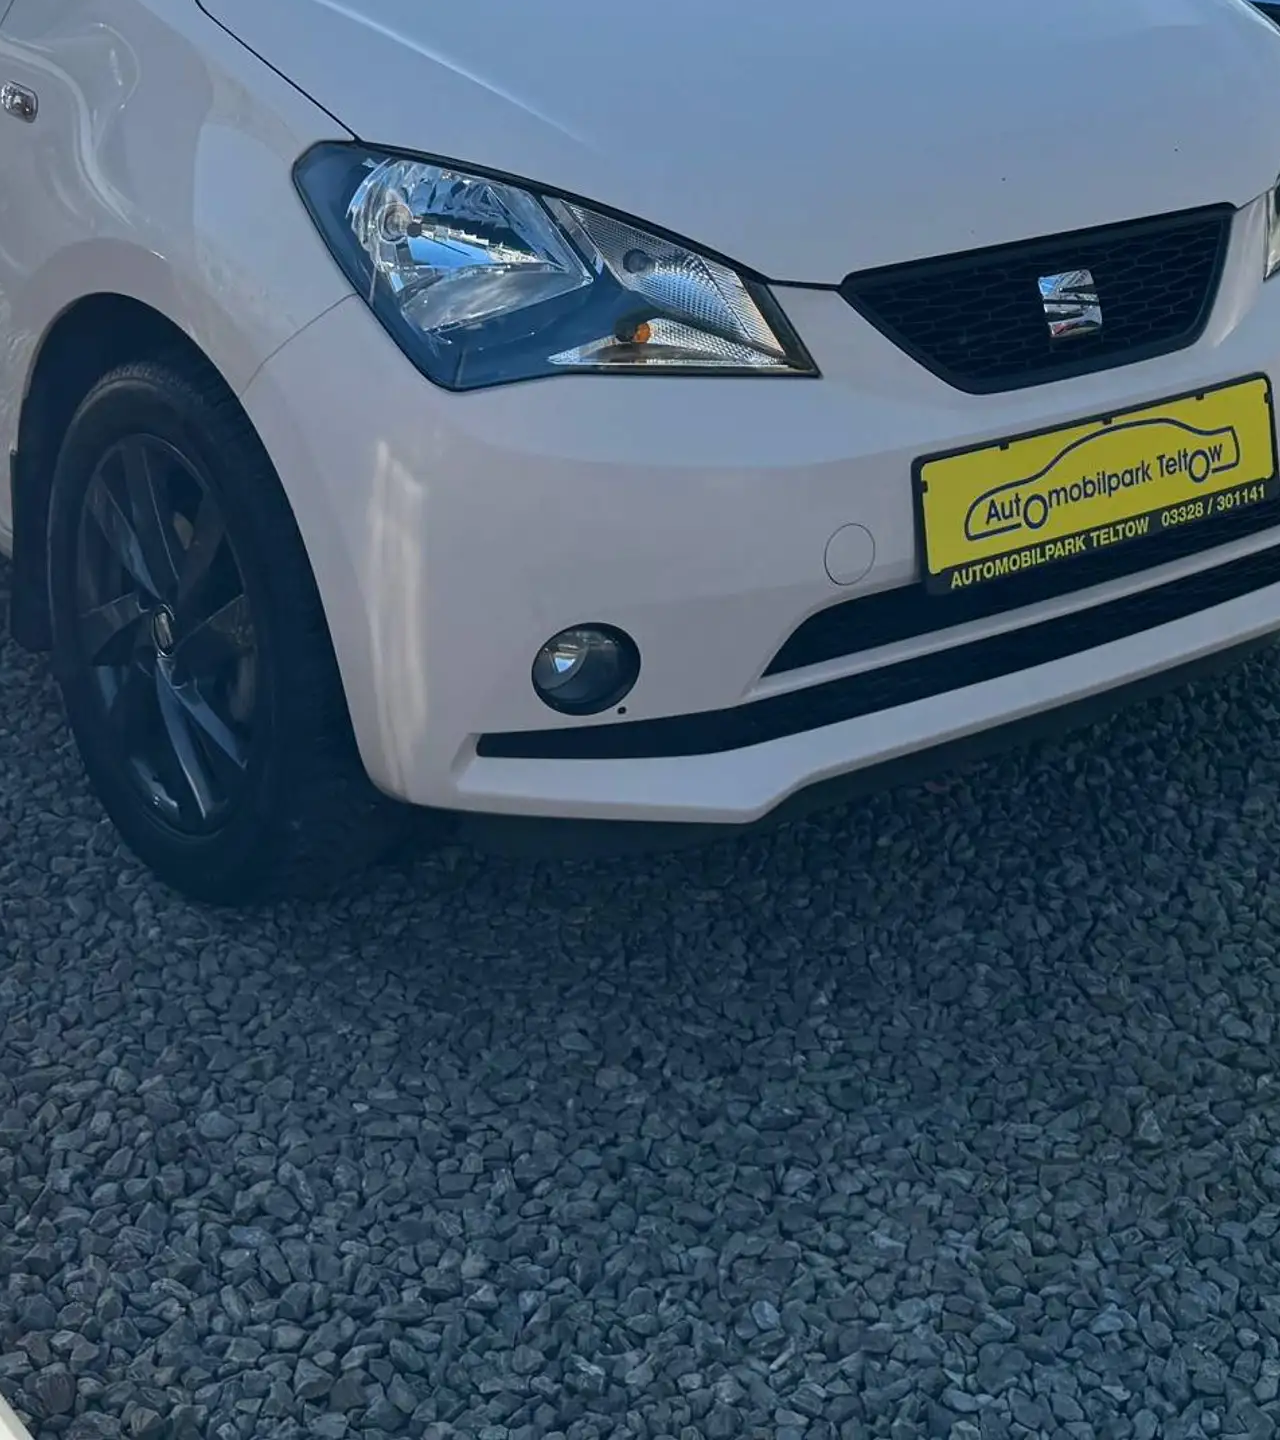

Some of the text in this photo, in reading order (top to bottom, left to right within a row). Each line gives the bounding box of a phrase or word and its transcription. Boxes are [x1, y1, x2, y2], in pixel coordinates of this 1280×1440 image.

[951, 536, 1087, 589] AUTOMOBILPARK
[1090, 517, 1150, 547] TELTOW
[1161, 504, 1204, 527] 03328
[1217, 484, 1266, 509] 301141
